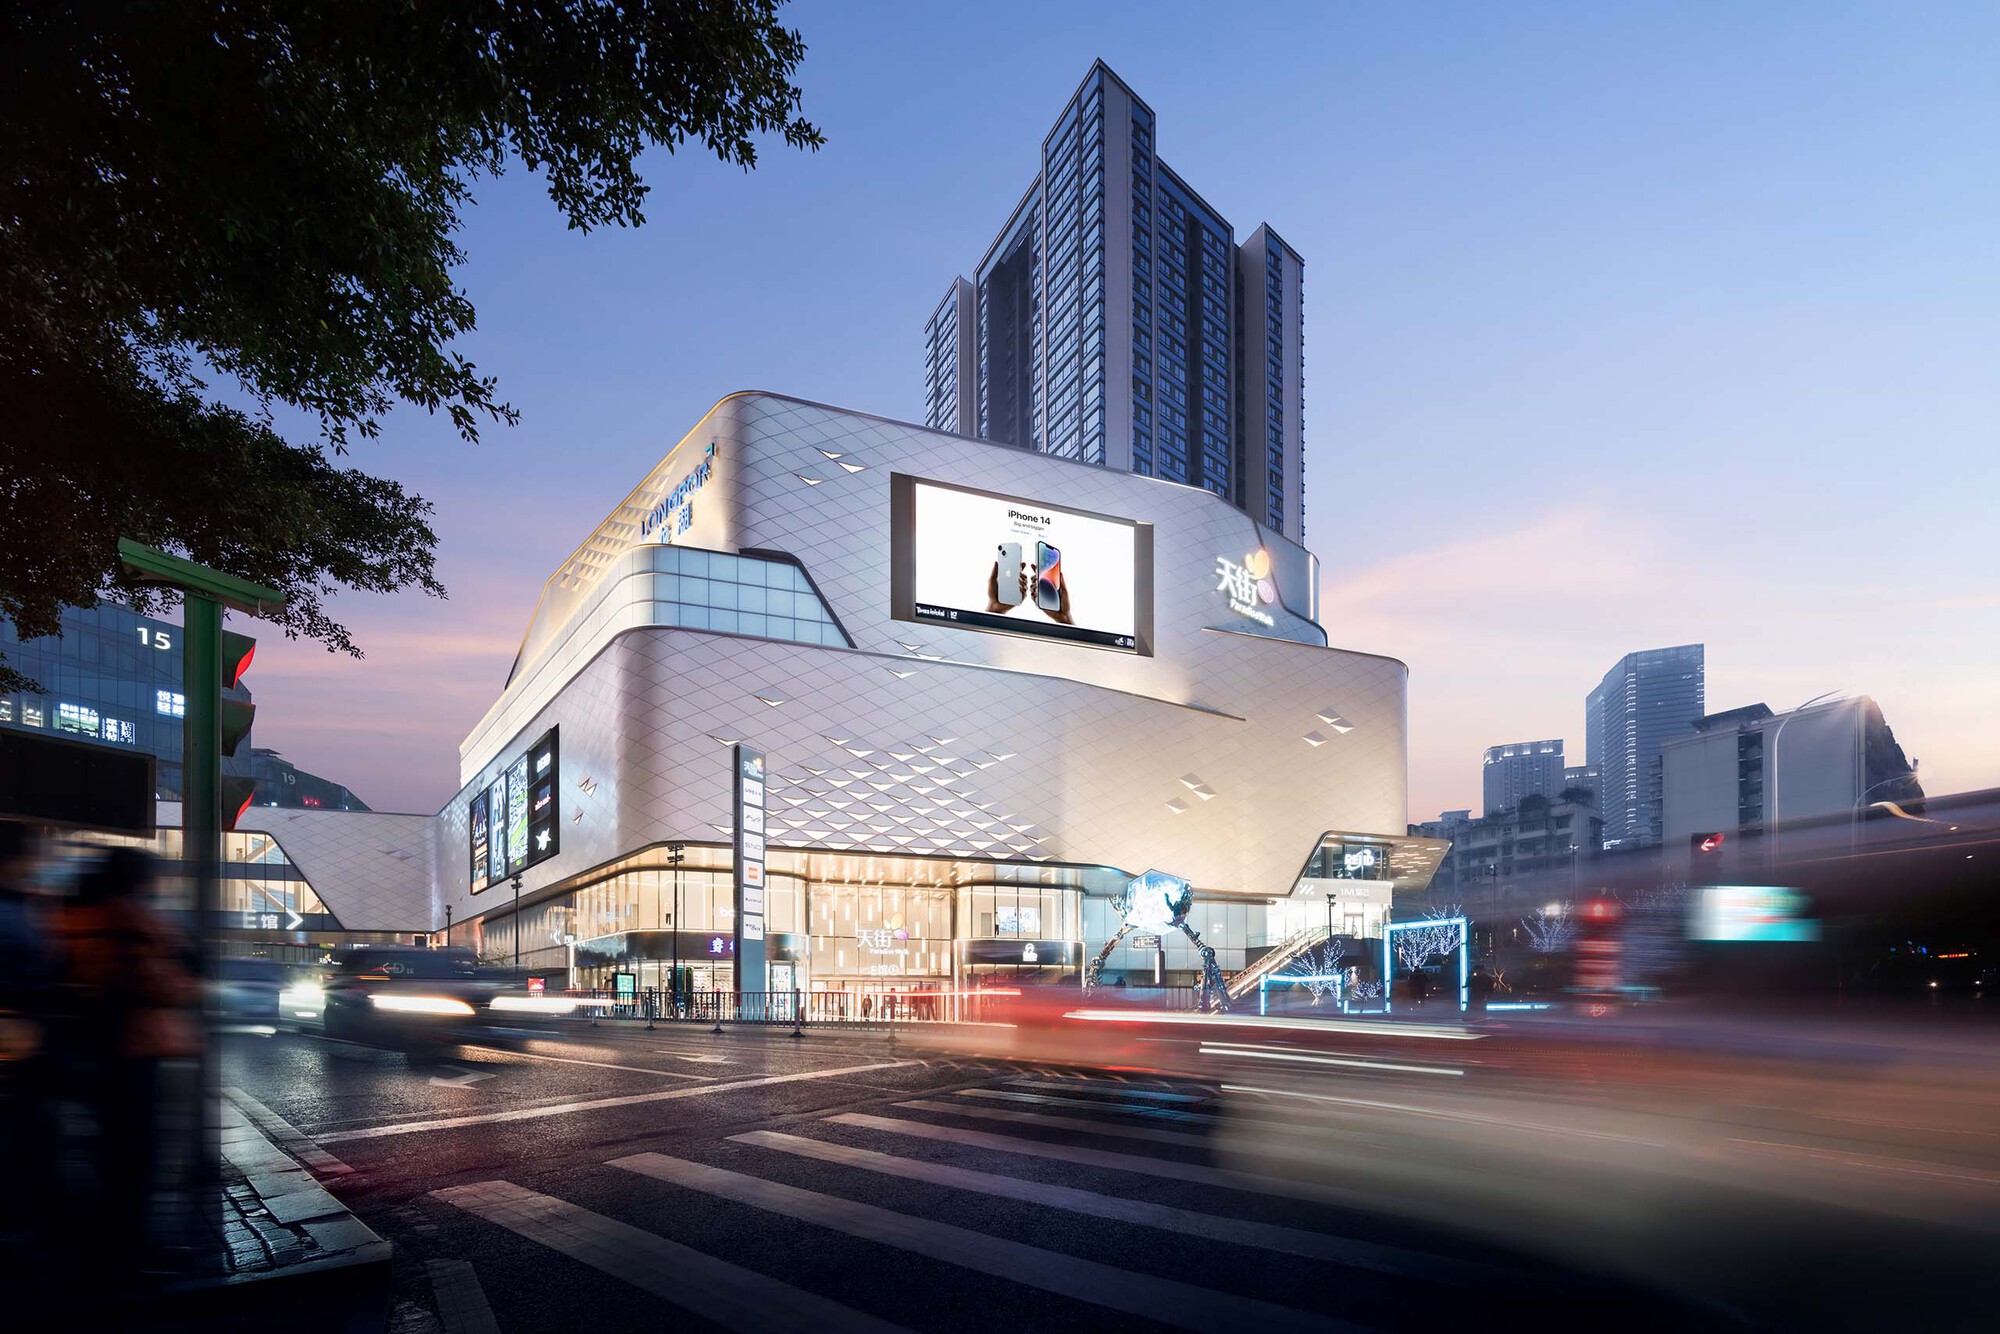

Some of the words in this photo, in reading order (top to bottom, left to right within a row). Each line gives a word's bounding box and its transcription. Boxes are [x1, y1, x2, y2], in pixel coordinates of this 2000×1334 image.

[641, 462, 710, 539] LONGFOR
[1008, 510, 1038, 522] iPhone
[1040, 516, 1051, 525] 14
[1216, 557, 1257, 607] 天街
[138, 627, 171, 650] 15
[282, 772, 296, 785] 19
[857, 930, 892, 948] 天街
